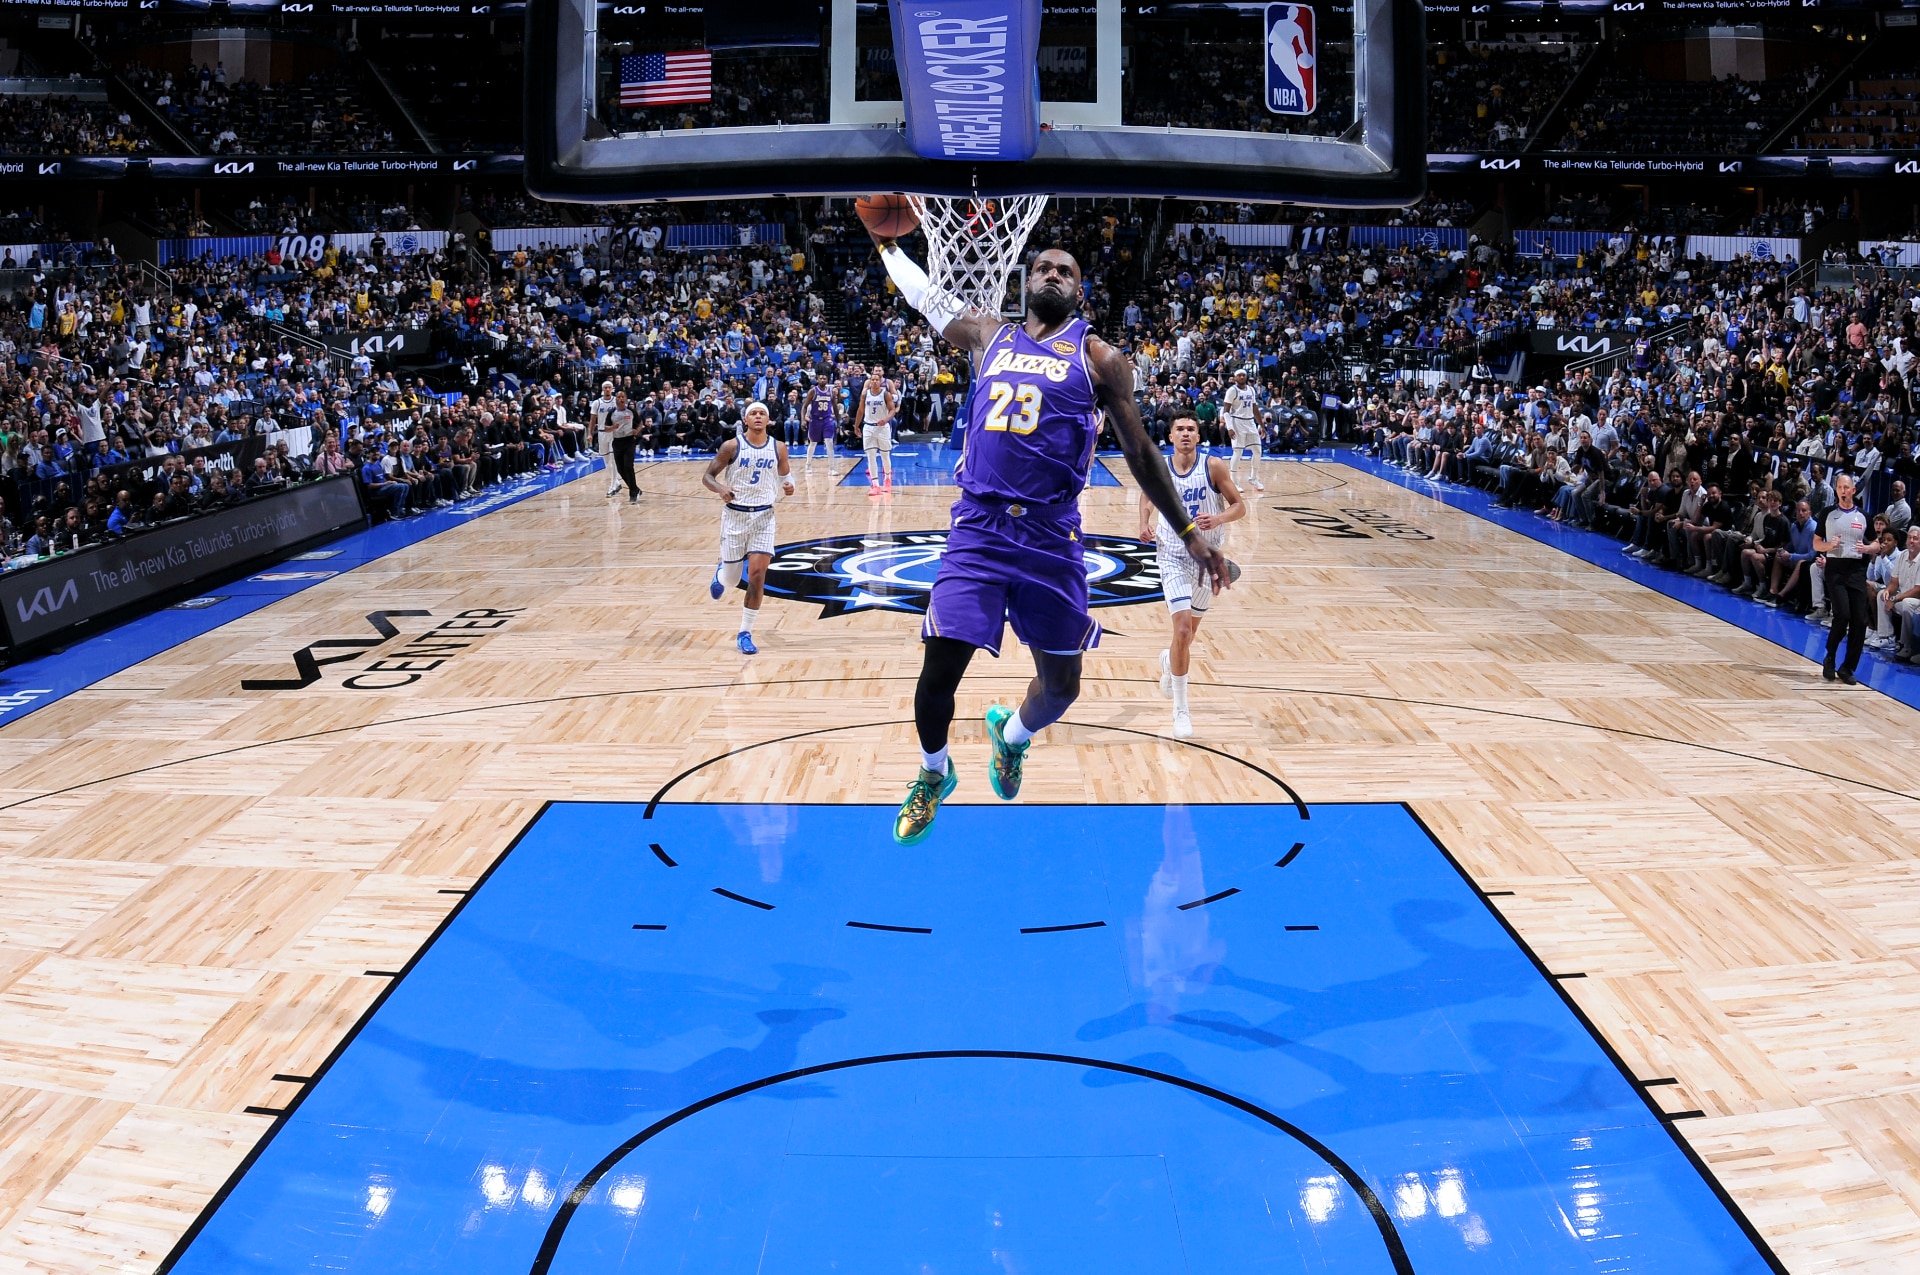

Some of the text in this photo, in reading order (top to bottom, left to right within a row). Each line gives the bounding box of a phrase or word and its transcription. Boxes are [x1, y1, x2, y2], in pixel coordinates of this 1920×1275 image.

[83, 0, 129, 8] Turbo-Hybrid
[281, 4, 313, 12] KIA
[415, 5, 460, 14] Turbo-Hybrid
[613, 6, 646, 15] KIA
[1613, 3, 1645, 12] KIA
[1746, 0, 1791, 8] Tubo-Hybrid
[918, 15, 1008, 156] THREATLOCKER
[1273, 87, 1297, 107] NBA
[214, 162, 255, 174] KIA
[277, 160, 438, 172] The all-new Kia Telluride Turbo-Hybrid
[1480, 158, 1520, 170] KIA
[1543, 159, 1704, 172] The all-new Kia Telluride Turbo-Hybrid
[277, 235, 326, 262] 108
[350, 334, 405, 353] KIA
[1557, 335, 1611, 354] KIA
[983, 348, 1071, 382] LAKERS
[984, 382, 1043, 435] 23
[749, 470, 761, 484] 5
[1182, 486, 1207, 502] GIC
[767, 533, 948, 571] ORLAN
[16, 508, 297, 622] KIA The all-new Kia Telluride Turbo-Hybrid
[342, 607, 528, 690] CENTER
